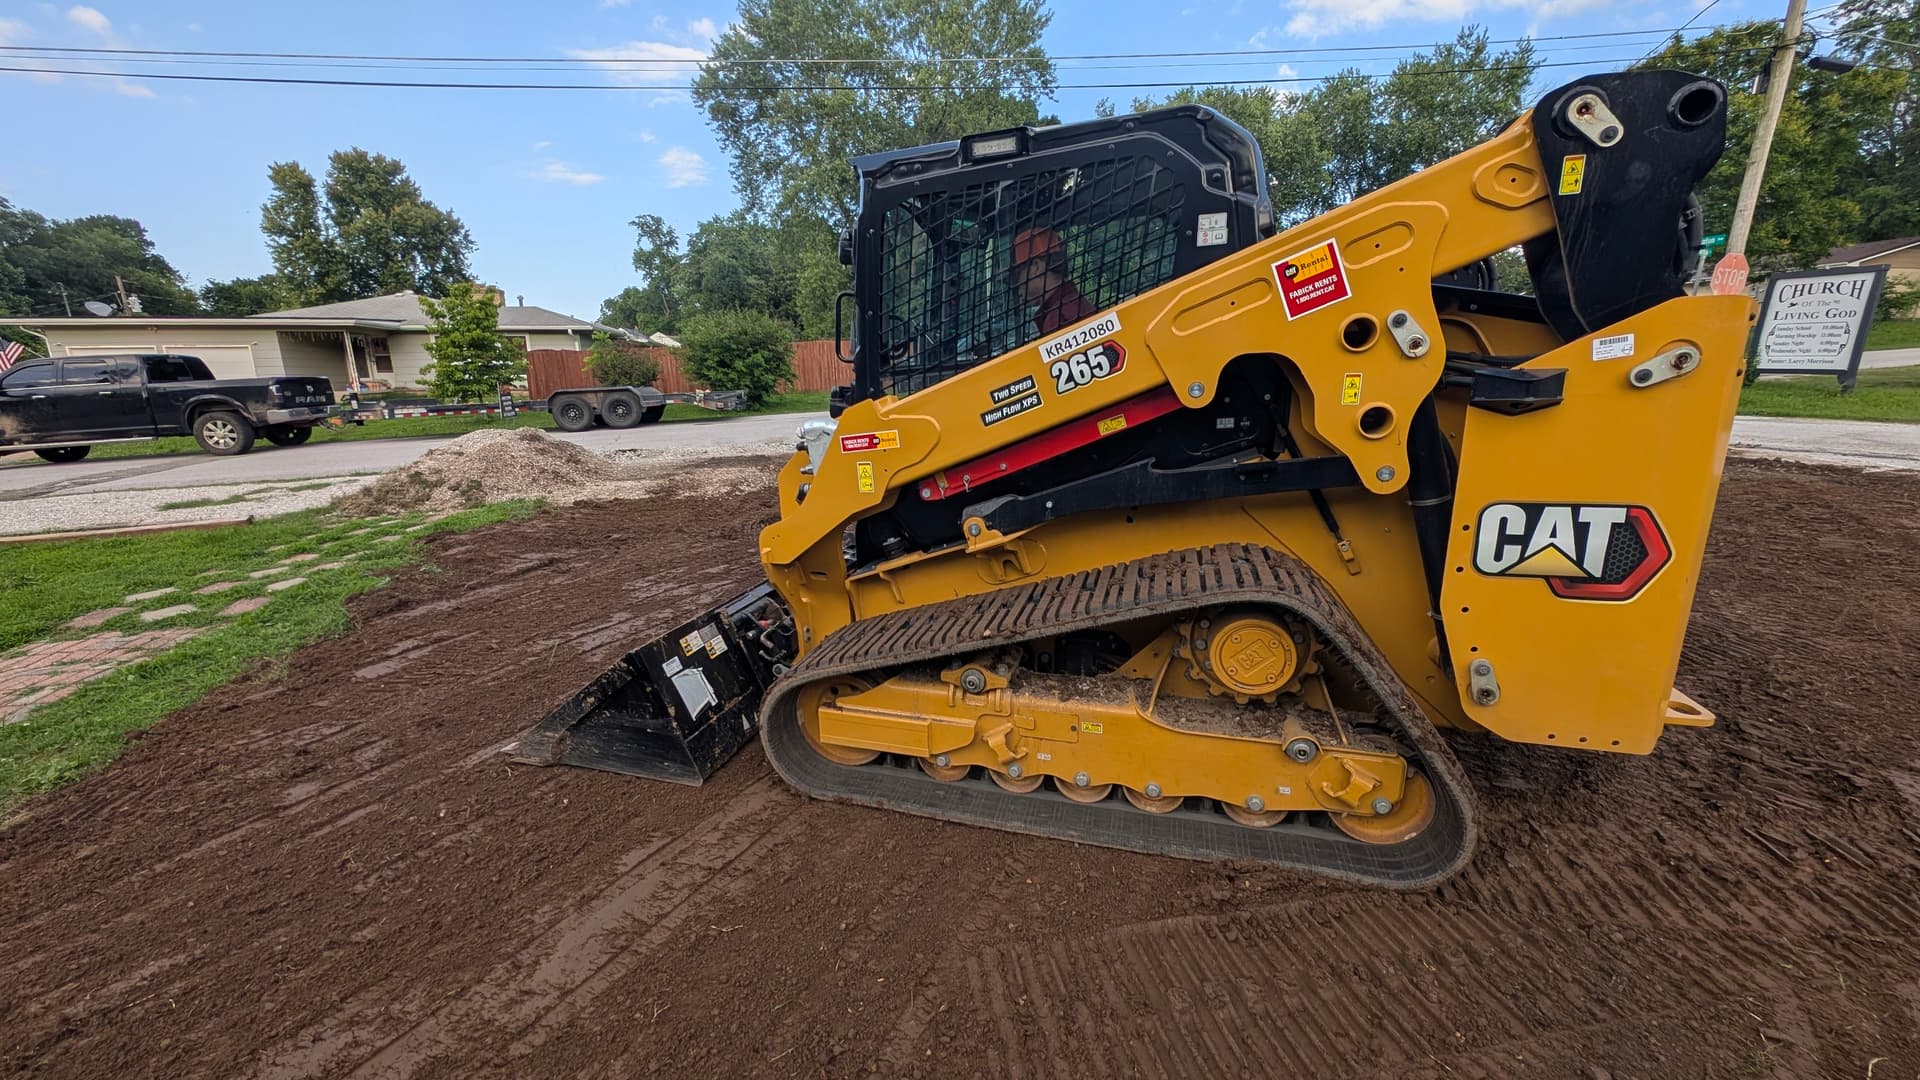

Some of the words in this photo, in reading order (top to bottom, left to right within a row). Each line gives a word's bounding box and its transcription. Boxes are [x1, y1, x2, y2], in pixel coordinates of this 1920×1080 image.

[1285, 267, 1297, 277] CAT
[1300, 254, 1329, 271] Rental
[1714, 268, 1746, 286] STOP
[1289, 286, 1314, 300] FABICK
[1314, 274, 1338, 288] RENTS
[1778, 279, 1865, 303] CHURCH
[1773, 310, 1820, 321] LIVING
[1825, 307, 1857, 319] GOD
[1045, 319, 1115, 359] KR412080
[1051, 345, 1111, 394] 265
[295, 396, 326, 404] RAM
[993, 389, 1010, 401] TWO
[1010, 379, 1033, 395] SPEED
[985, 409, 1002, 423] HIGH
[1003, 401, 1021, 416] FLOW
[1022, 395, 1039, 409] XPS
[1476, 504, 1628, 578] CAT
[1239, 644, 1266, 669] CAT
